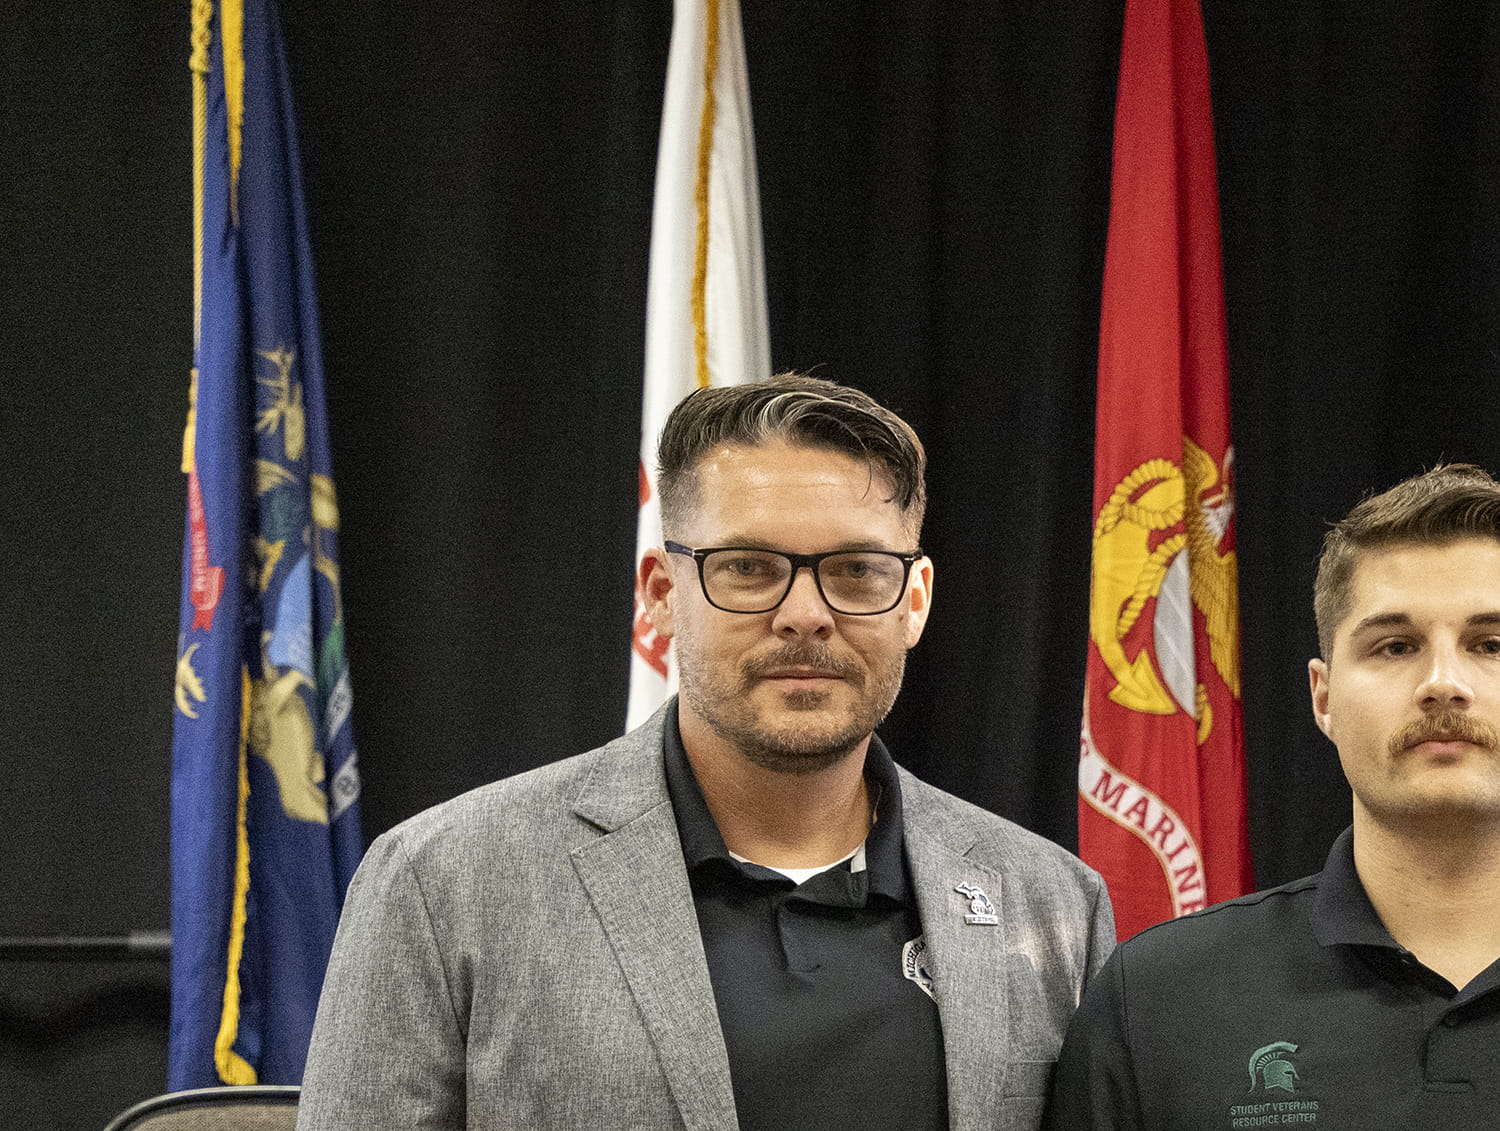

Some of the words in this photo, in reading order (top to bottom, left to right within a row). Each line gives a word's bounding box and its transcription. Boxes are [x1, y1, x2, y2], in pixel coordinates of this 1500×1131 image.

[1230, 1103, 1271, 1116] STUDENT
[1272, 1101, 1319, 1112] VETERANS
[1232, 1114, 1280, 1128] RESOURCE
[1281, 1112, 1317, 1123] CENTER
